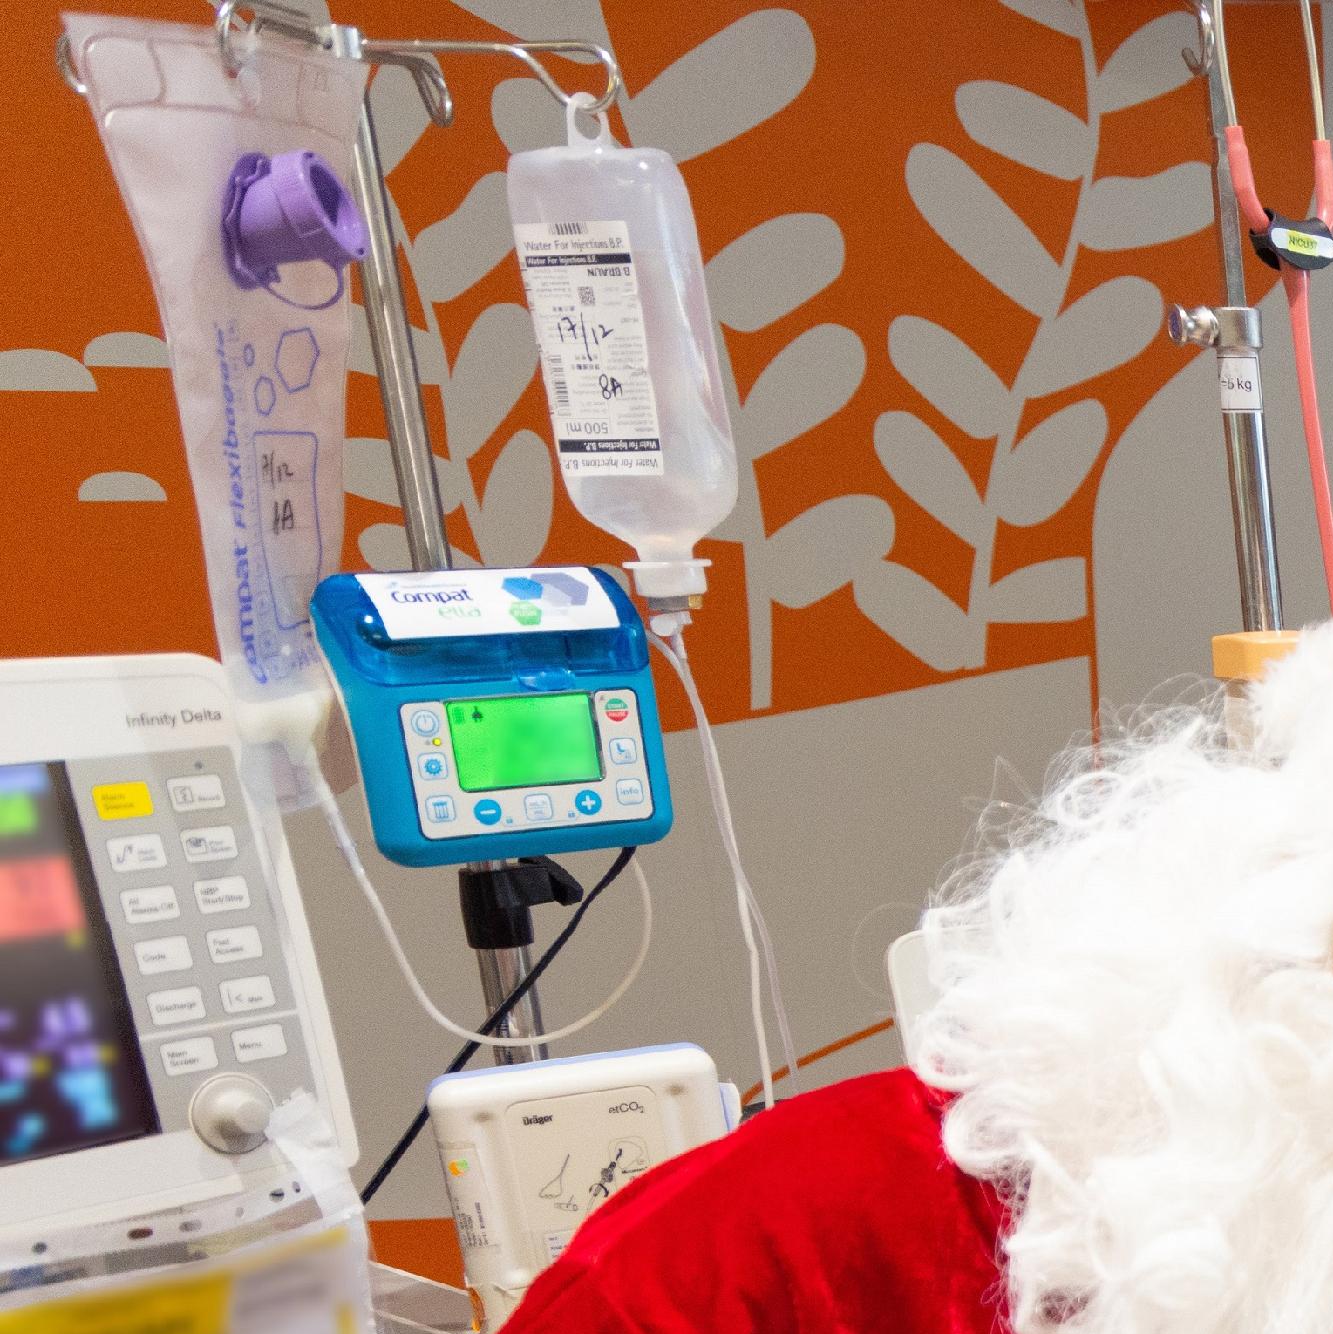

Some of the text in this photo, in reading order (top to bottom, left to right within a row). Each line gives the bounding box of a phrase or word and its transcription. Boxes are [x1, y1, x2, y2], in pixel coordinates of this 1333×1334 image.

[524, 240, 552, 251] Water
[554, 240, 569, 250] For
[1237, 378, 1252, 392] kg
[584, 422, 609, 434] 500
[391, 588, 474, 604] Compat
[438, 605, 482, 619] ella
[125, 708, 222, 727] Infinity Delta
[239, 1040, 263, 1049] Menu
[522, 1113, 553, 1126] Dräger
